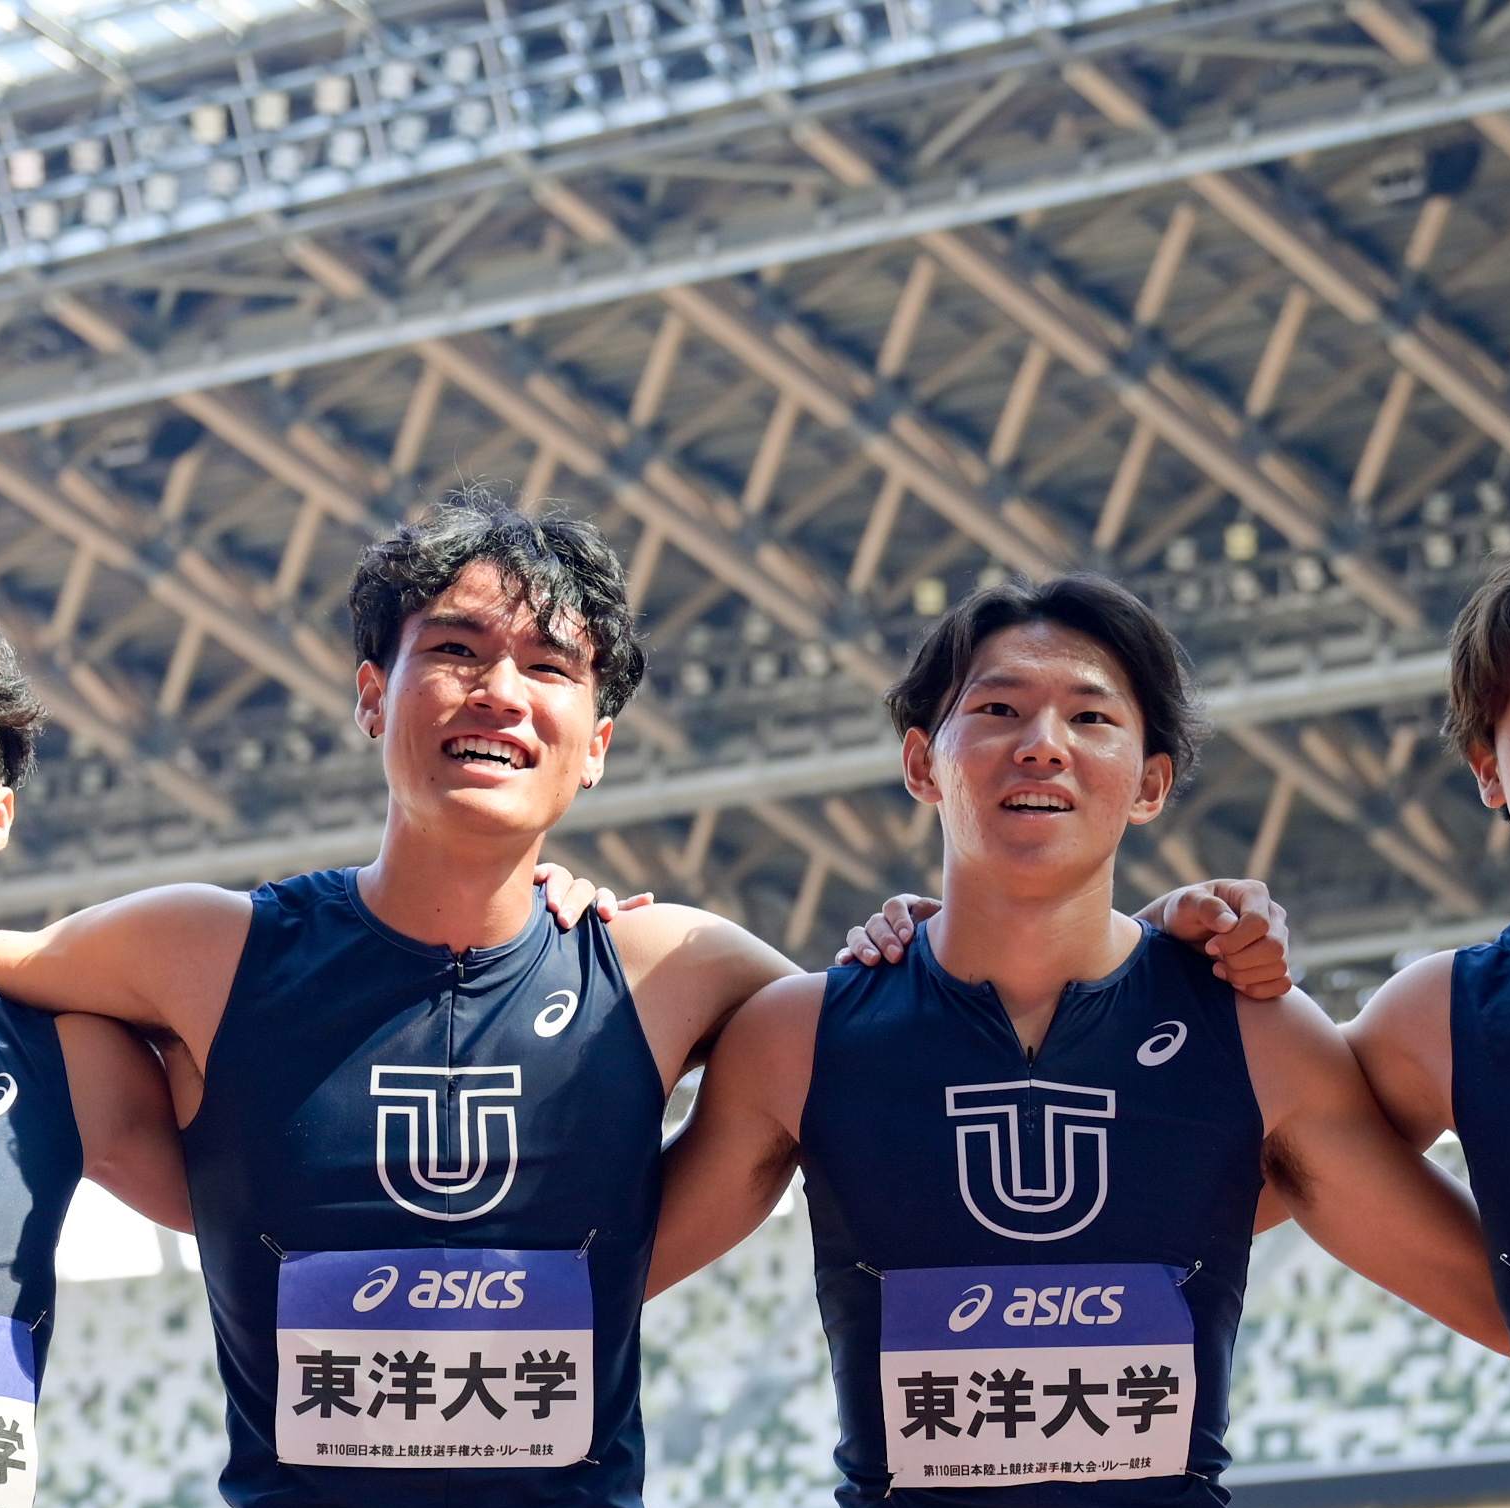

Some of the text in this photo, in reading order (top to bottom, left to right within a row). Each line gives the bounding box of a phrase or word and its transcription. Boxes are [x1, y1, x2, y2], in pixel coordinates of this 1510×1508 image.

[291, 1349, 577, 1422] 東洋大学
[897, 1363, 1180, 1441] 東洋大学
